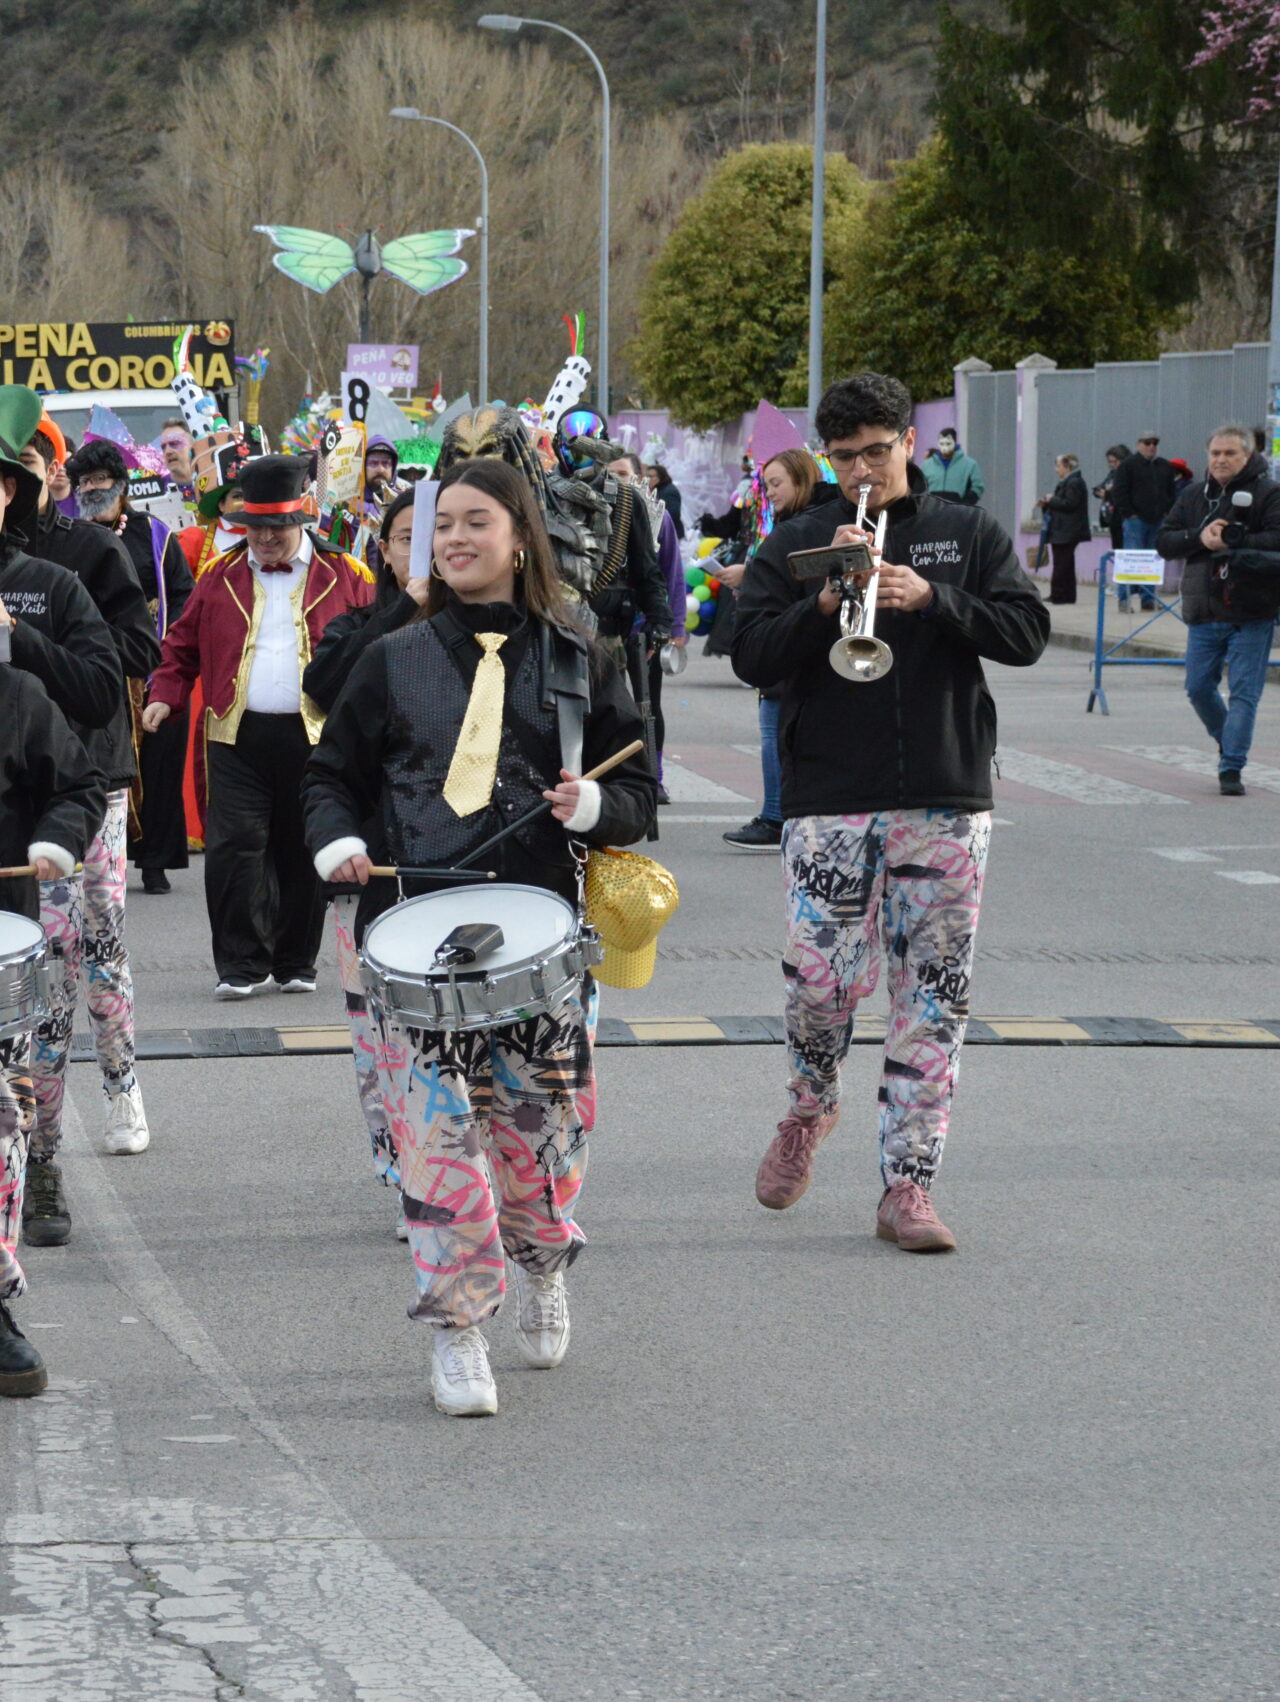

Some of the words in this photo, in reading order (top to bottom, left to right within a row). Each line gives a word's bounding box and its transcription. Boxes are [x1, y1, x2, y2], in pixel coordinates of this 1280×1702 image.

[909, 540, 959, 554] CHARANGA
[912, 554, 935, 567] Con
[935, 550, 963, 564] Xeito
[20, 601, 48, 615] Xeito
